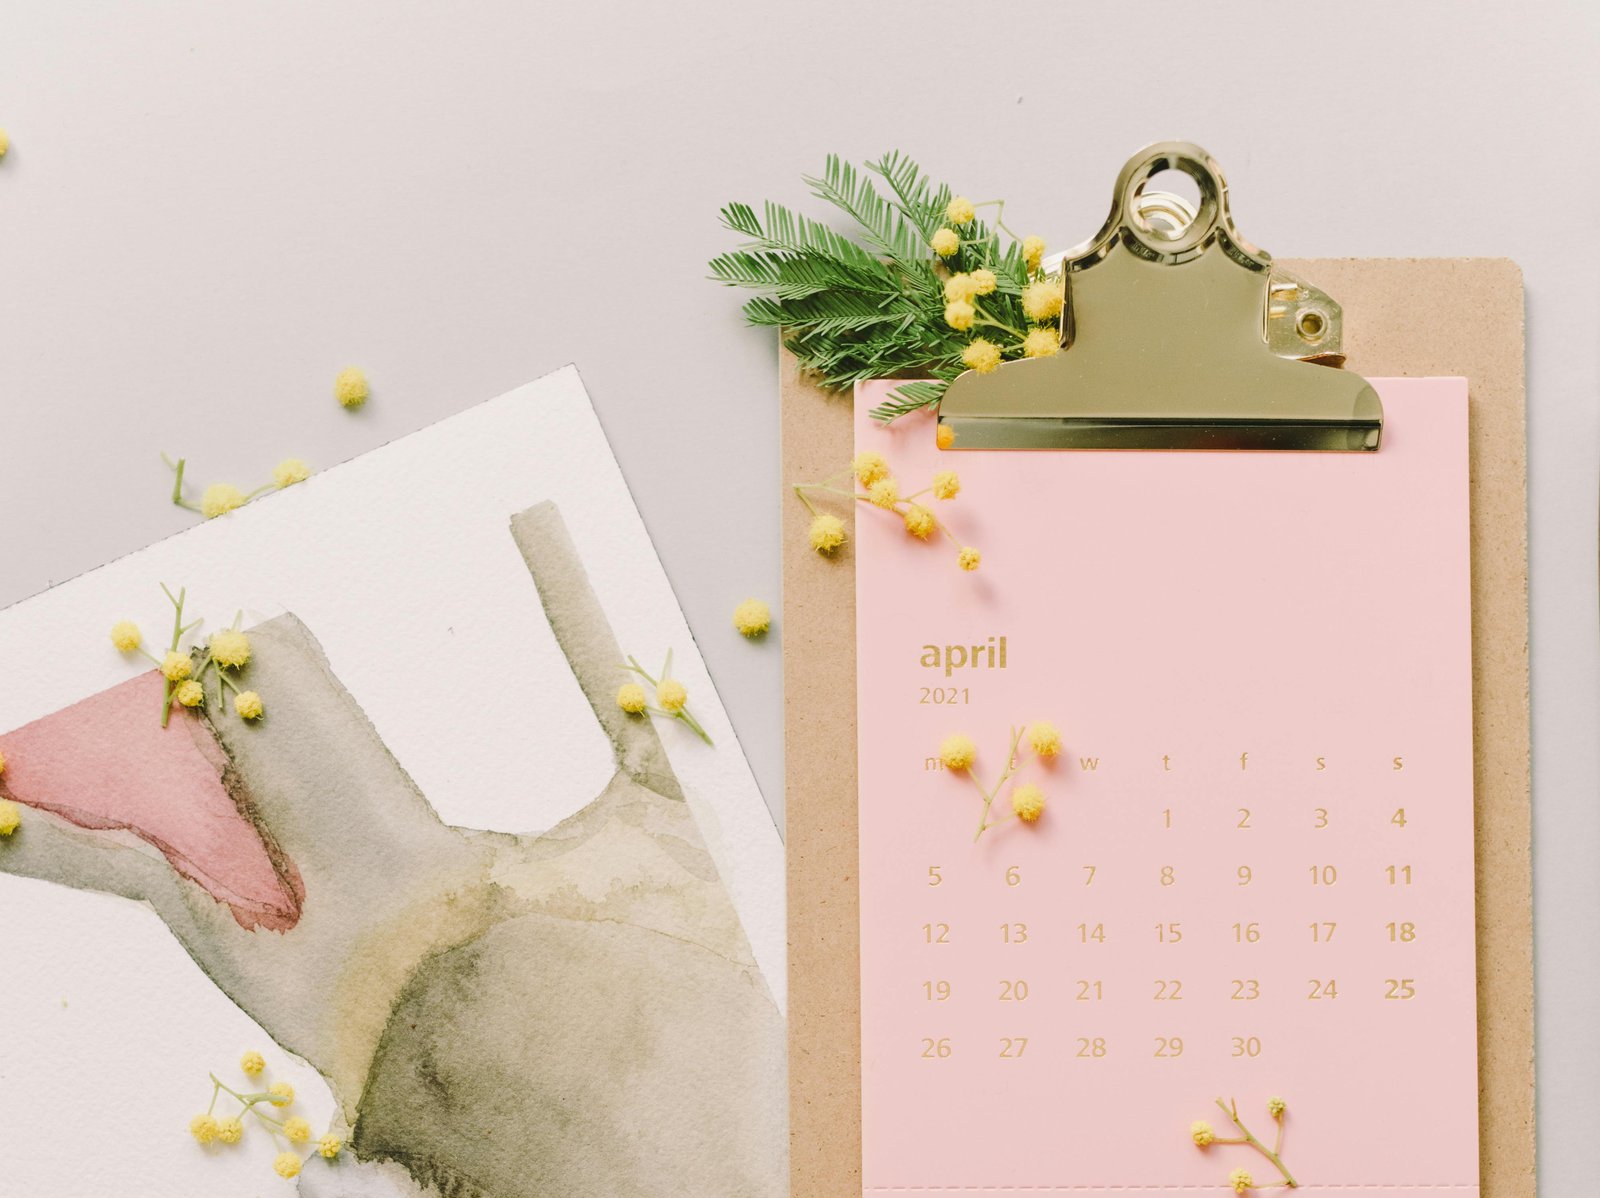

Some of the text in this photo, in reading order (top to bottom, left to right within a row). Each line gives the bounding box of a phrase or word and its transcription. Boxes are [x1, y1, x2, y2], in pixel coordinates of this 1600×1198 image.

[920, 636, 1007, 677] april
[920, 688, 968, 704] 2021
[1079, 757, 1100, 771] w
[1162, 754, 1172, 771] t
[1239, 752, 1249, 771] f
[1316, 757, 1326, 771] s
[1392, 757, 1403, 770] s
[1162, 808, 1407, 828] 1 2 3 4
[928, 864, 1412, 886] 5 6 7 8 9 10 11
[922, 922, 1416, 944] 12 13 14 15 16 17 18
[922, 979, 1416, 1001] 19 20 21 22 23 24 25
[921, 1037, 1261, 1058] 26 27 28 29 30
